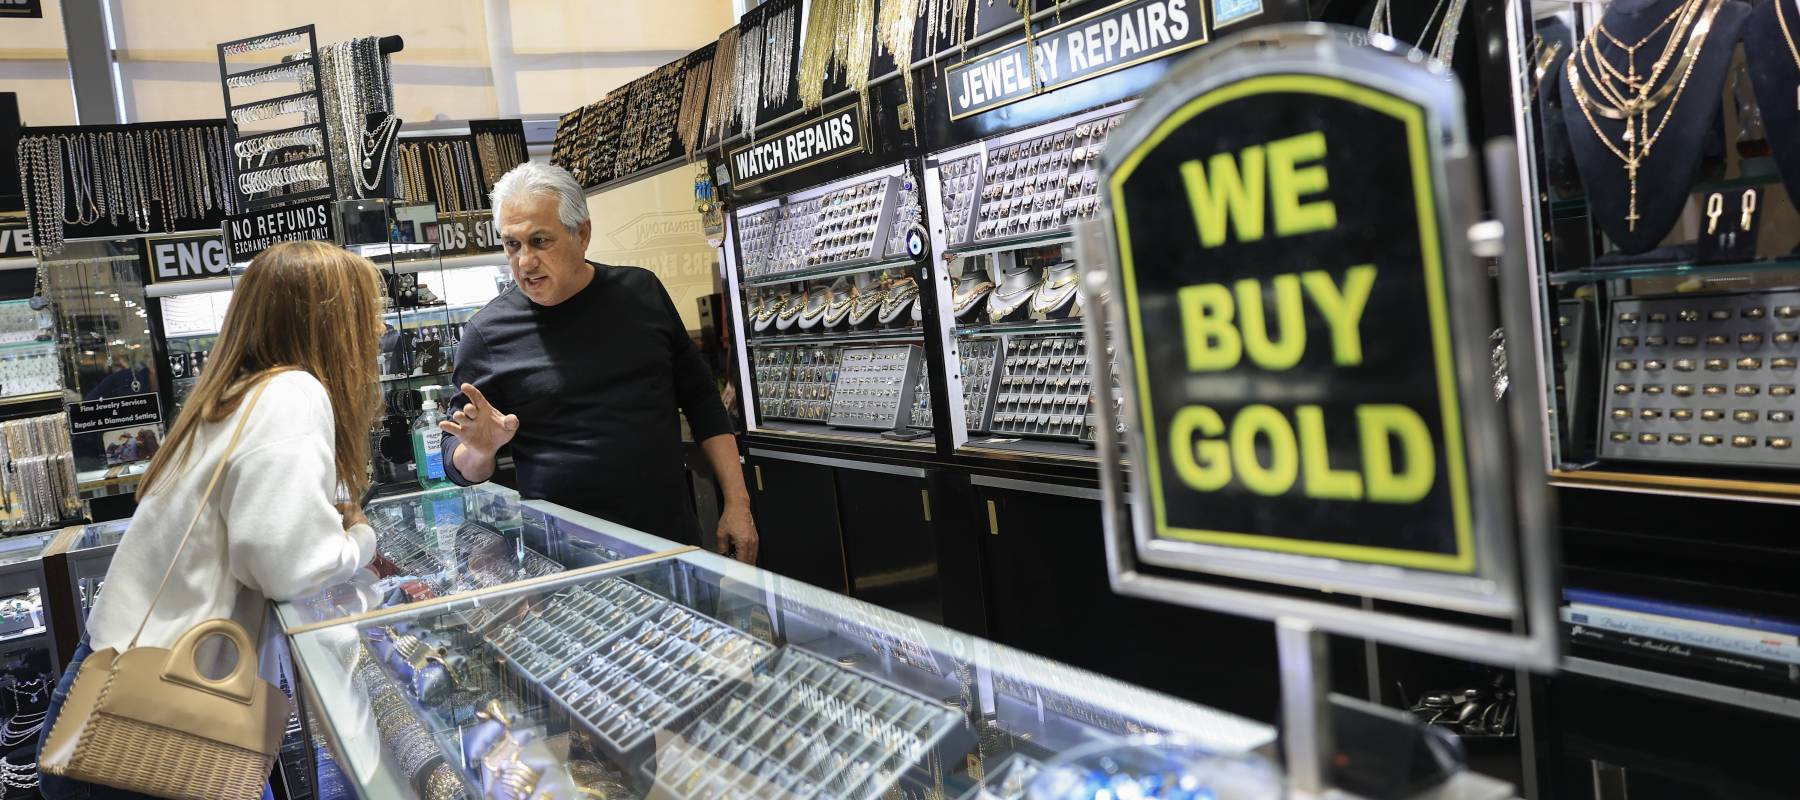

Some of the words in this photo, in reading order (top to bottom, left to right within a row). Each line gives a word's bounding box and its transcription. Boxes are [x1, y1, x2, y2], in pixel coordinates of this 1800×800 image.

[958, 37, 1061, 109] JEWELRY
[1067, 0, 1191, 73] REPAIRS
[735, 139, 785, 180] WATCH
[785, 113, 854, 164] REPAIRS
[232, 218, 252, 240] NO
[256, 204, 327, 236] REFUNDS
[1179, 129, 1338, 248] WE
[234, 237, 271, 254] EXCHANGE
[311, 226, 329, 240] ONLY
[1177, 263, 1379, 372] BUY
[74, 420, 97, 429] Repair
[104, 414, 134, 425] Diamond
[135, 411, 157, 421] Setting
[96, 402, 120, 411] Jewelry
[121, 398, 147, 407] Services
[1168, 403, 1437, 505] GOLD
